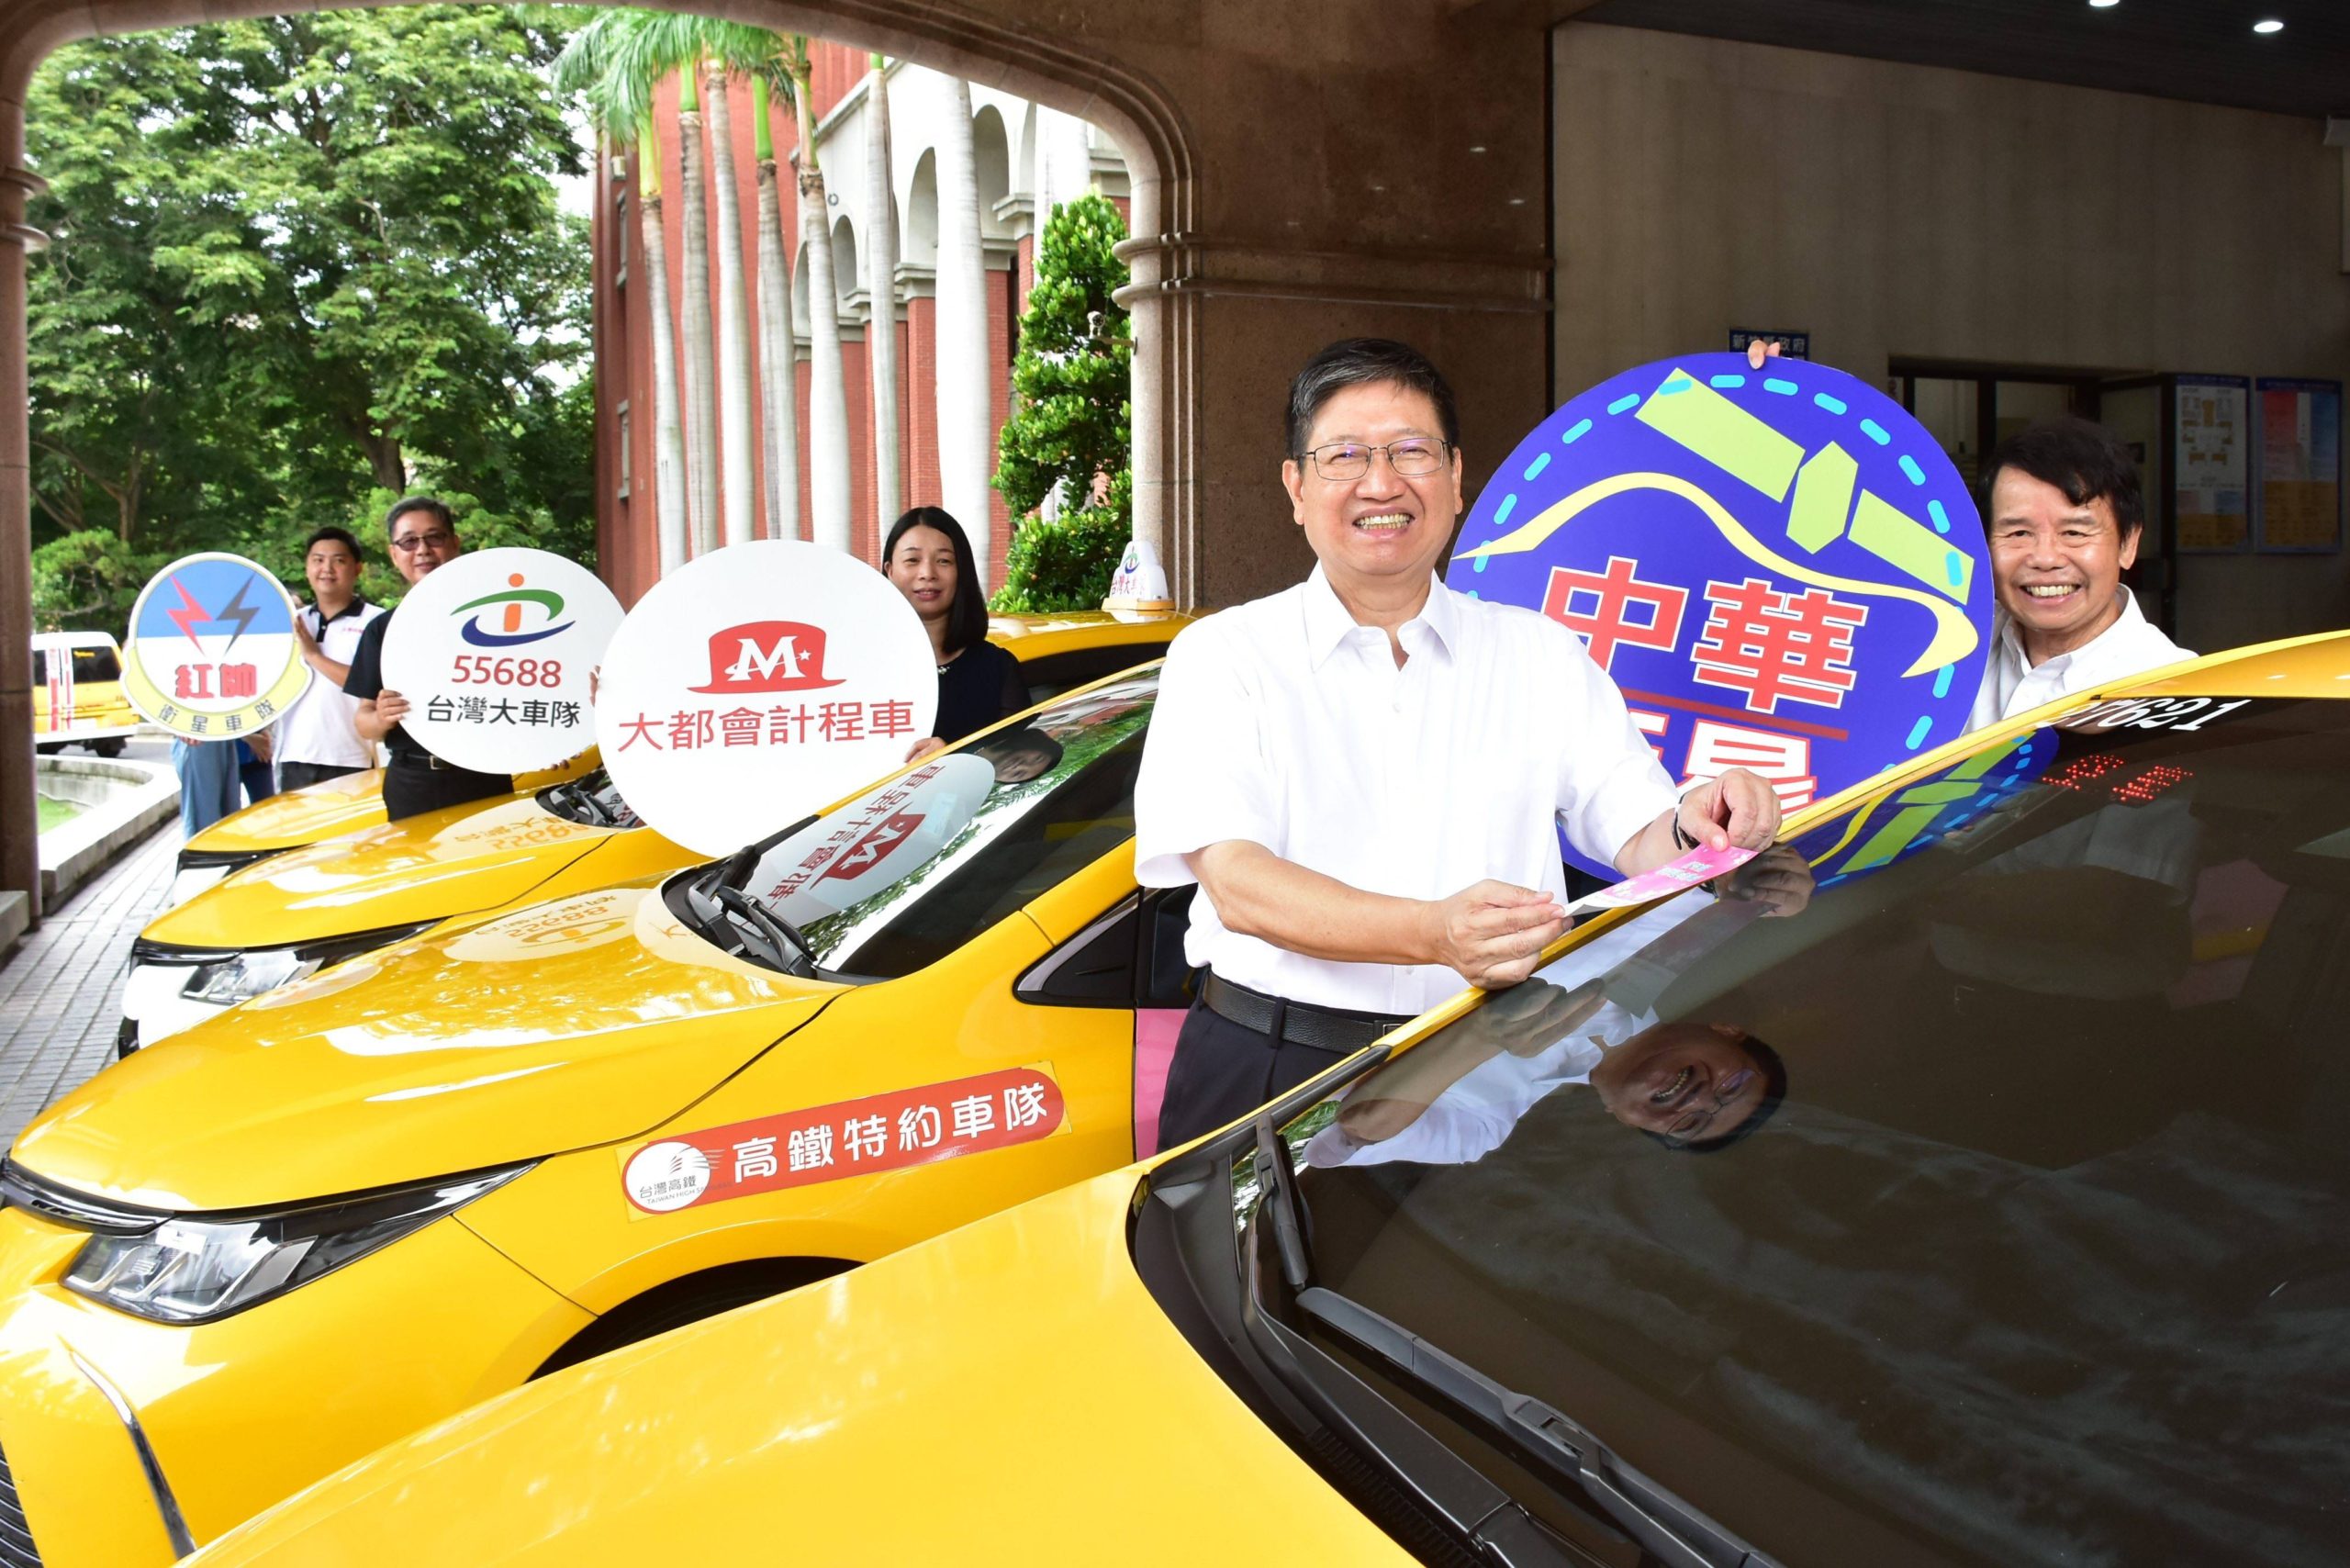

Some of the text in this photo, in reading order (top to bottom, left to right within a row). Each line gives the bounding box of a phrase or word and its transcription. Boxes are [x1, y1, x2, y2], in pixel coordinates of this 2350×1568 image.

[1540, 555, 1870, 715] 中華
[452, 655, 562, 688] 55688
[159, 700, 276, 734] 衛星車隊
[428, 695, 580, 728] 台灣大車隊
[618, 700, 915, 753] 大都會計程車
[1621, 708, 1827, 821] 星
[732, 1081, 1047, 1183] 高鐵特約車隊
[640, 1175, 697, 1199] 台灣高鐵
[646, 1194, 675, 1204] TAIWAN
